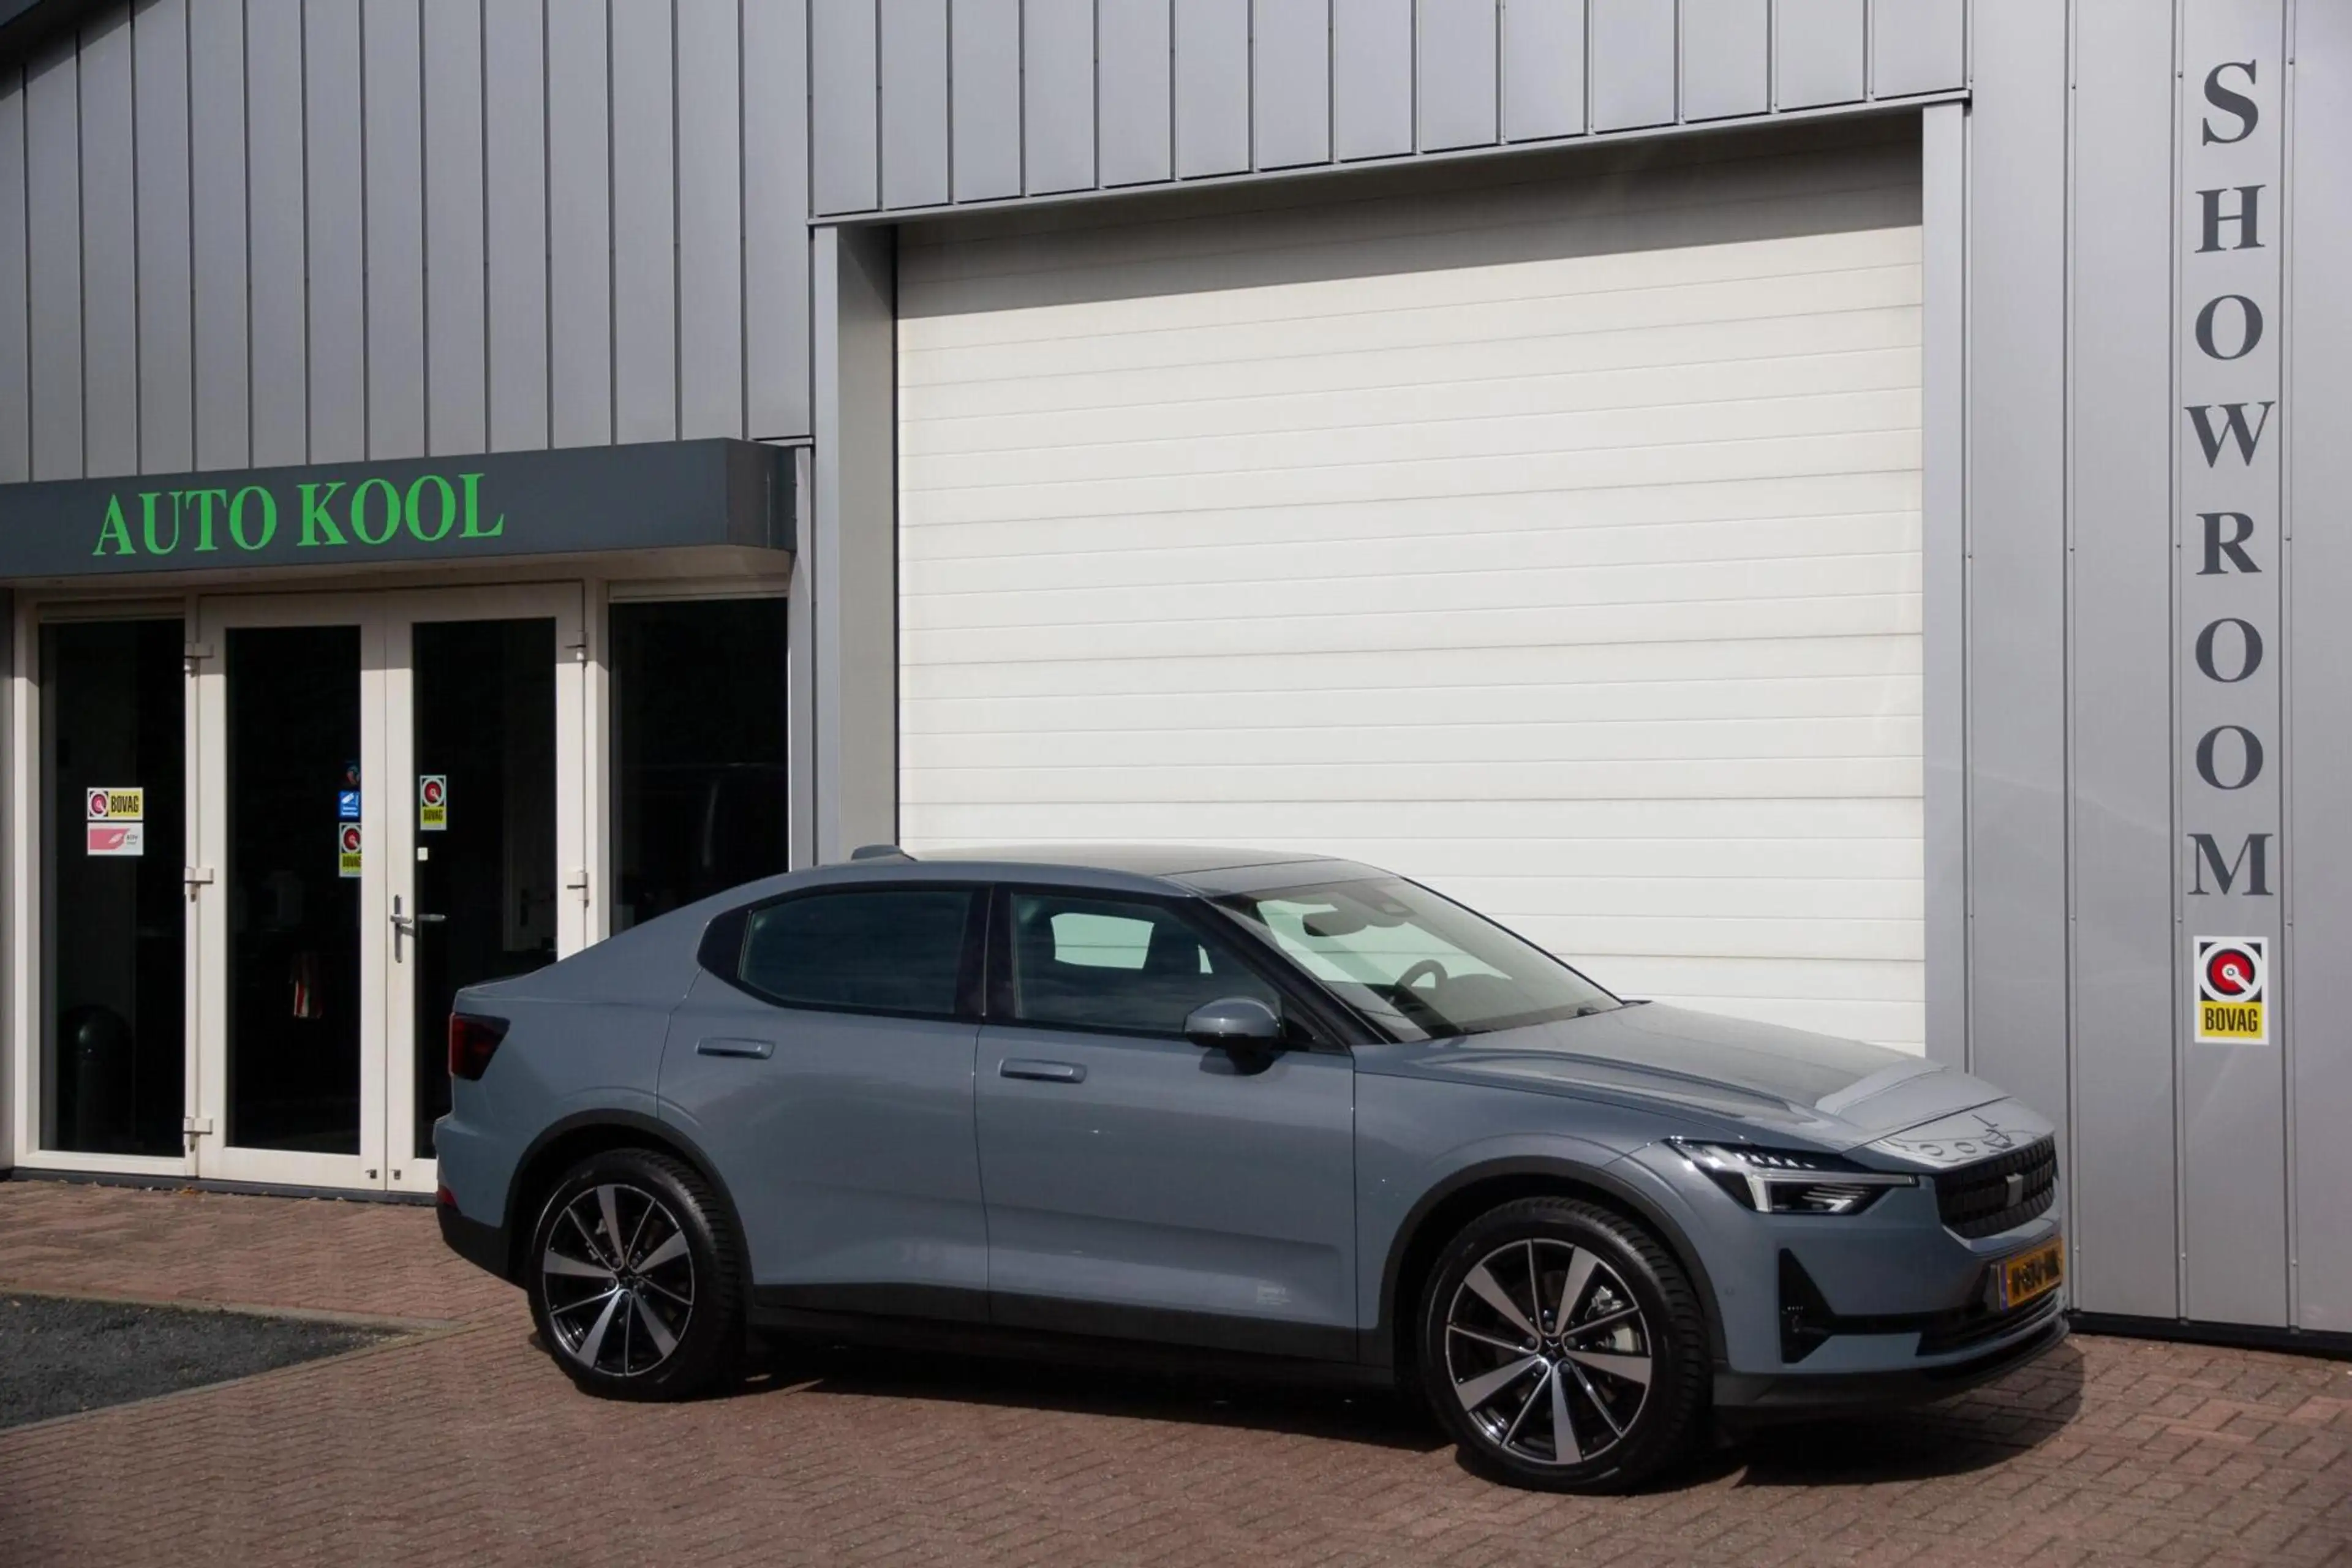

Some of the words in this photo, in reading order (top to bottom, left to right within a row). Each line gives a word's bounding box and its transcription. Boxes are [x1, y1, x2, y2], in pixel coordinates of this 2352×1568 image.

[2184, 59, 2275, 896] SHOWROOM
[92, 486, 277, 556] AUTO
[296, 472, 505, 546] KOOL
[111, 795, 140, 813] BOVAG
[423, 808, 443, 821] BOVAG
[2204, 1008, 2258, 1032] BOVAG
